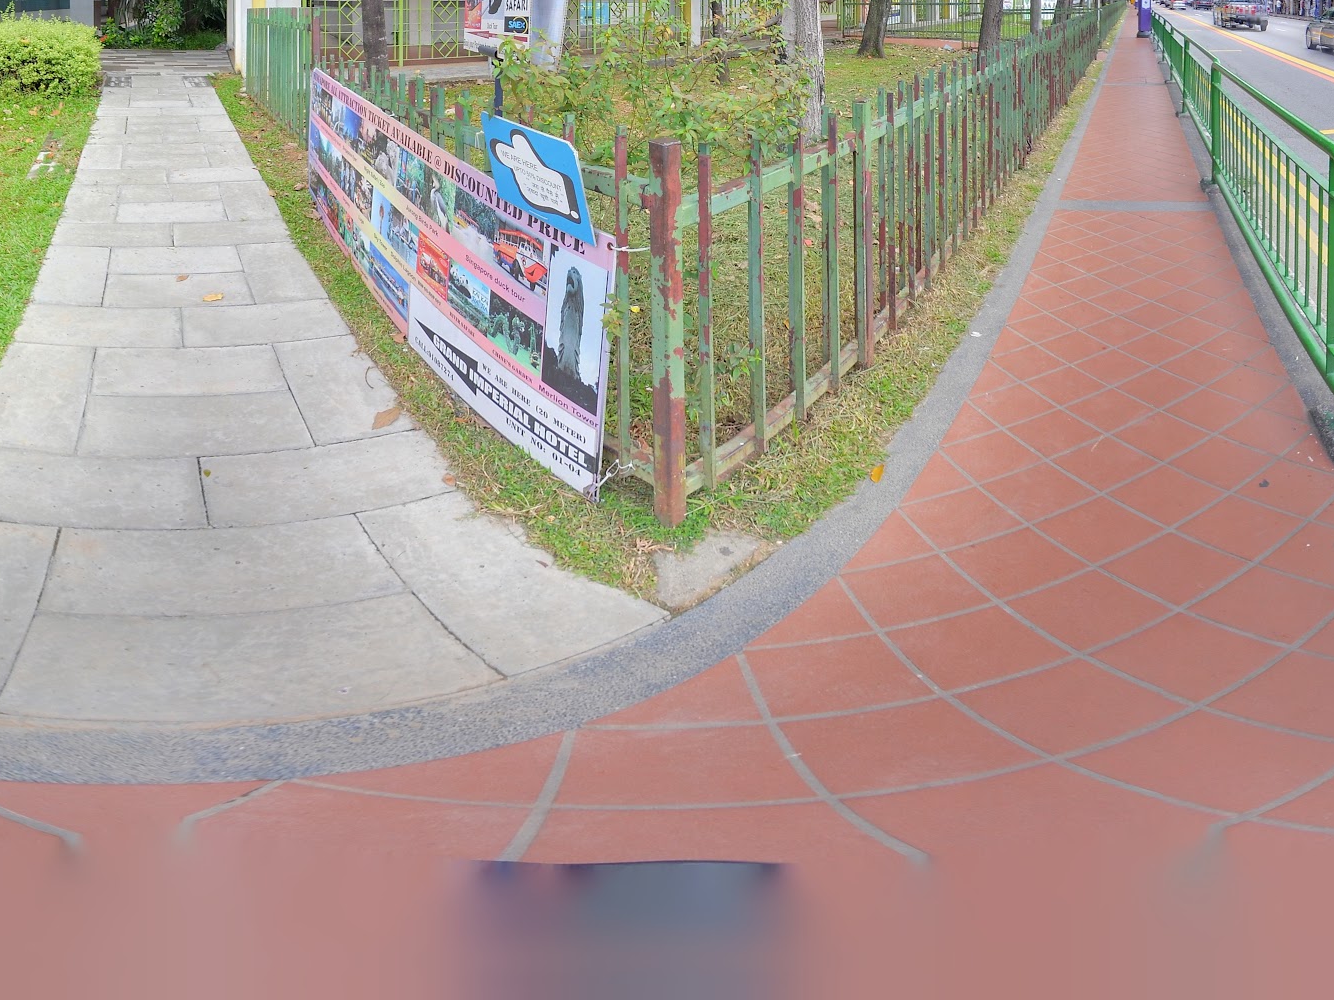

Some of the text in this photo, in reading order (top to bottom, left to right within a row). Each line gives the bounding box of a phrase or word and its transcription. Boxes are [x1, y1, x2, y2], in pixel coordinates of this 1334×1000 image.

[338, 88, 368, 118] ATTRACTION
[368, 110, 390, 133] TICKET
[391, 126, 433, 164] AVAILABLE
[444, 160, 523, 221] DISCOUNTED
[527, 214, 586, 255] PRICE
[465, 254, 526, 303] Singapore duck tour
[433, 334, 588, 468] GRAND IMPERIAL HOTEL
[482, 363, 586, 444] WE ARE HERE (20 METER)
[538, 384, 599, 428] Merlion Tower
[505, 416, 582, 477] UNIT NO: 01-04
